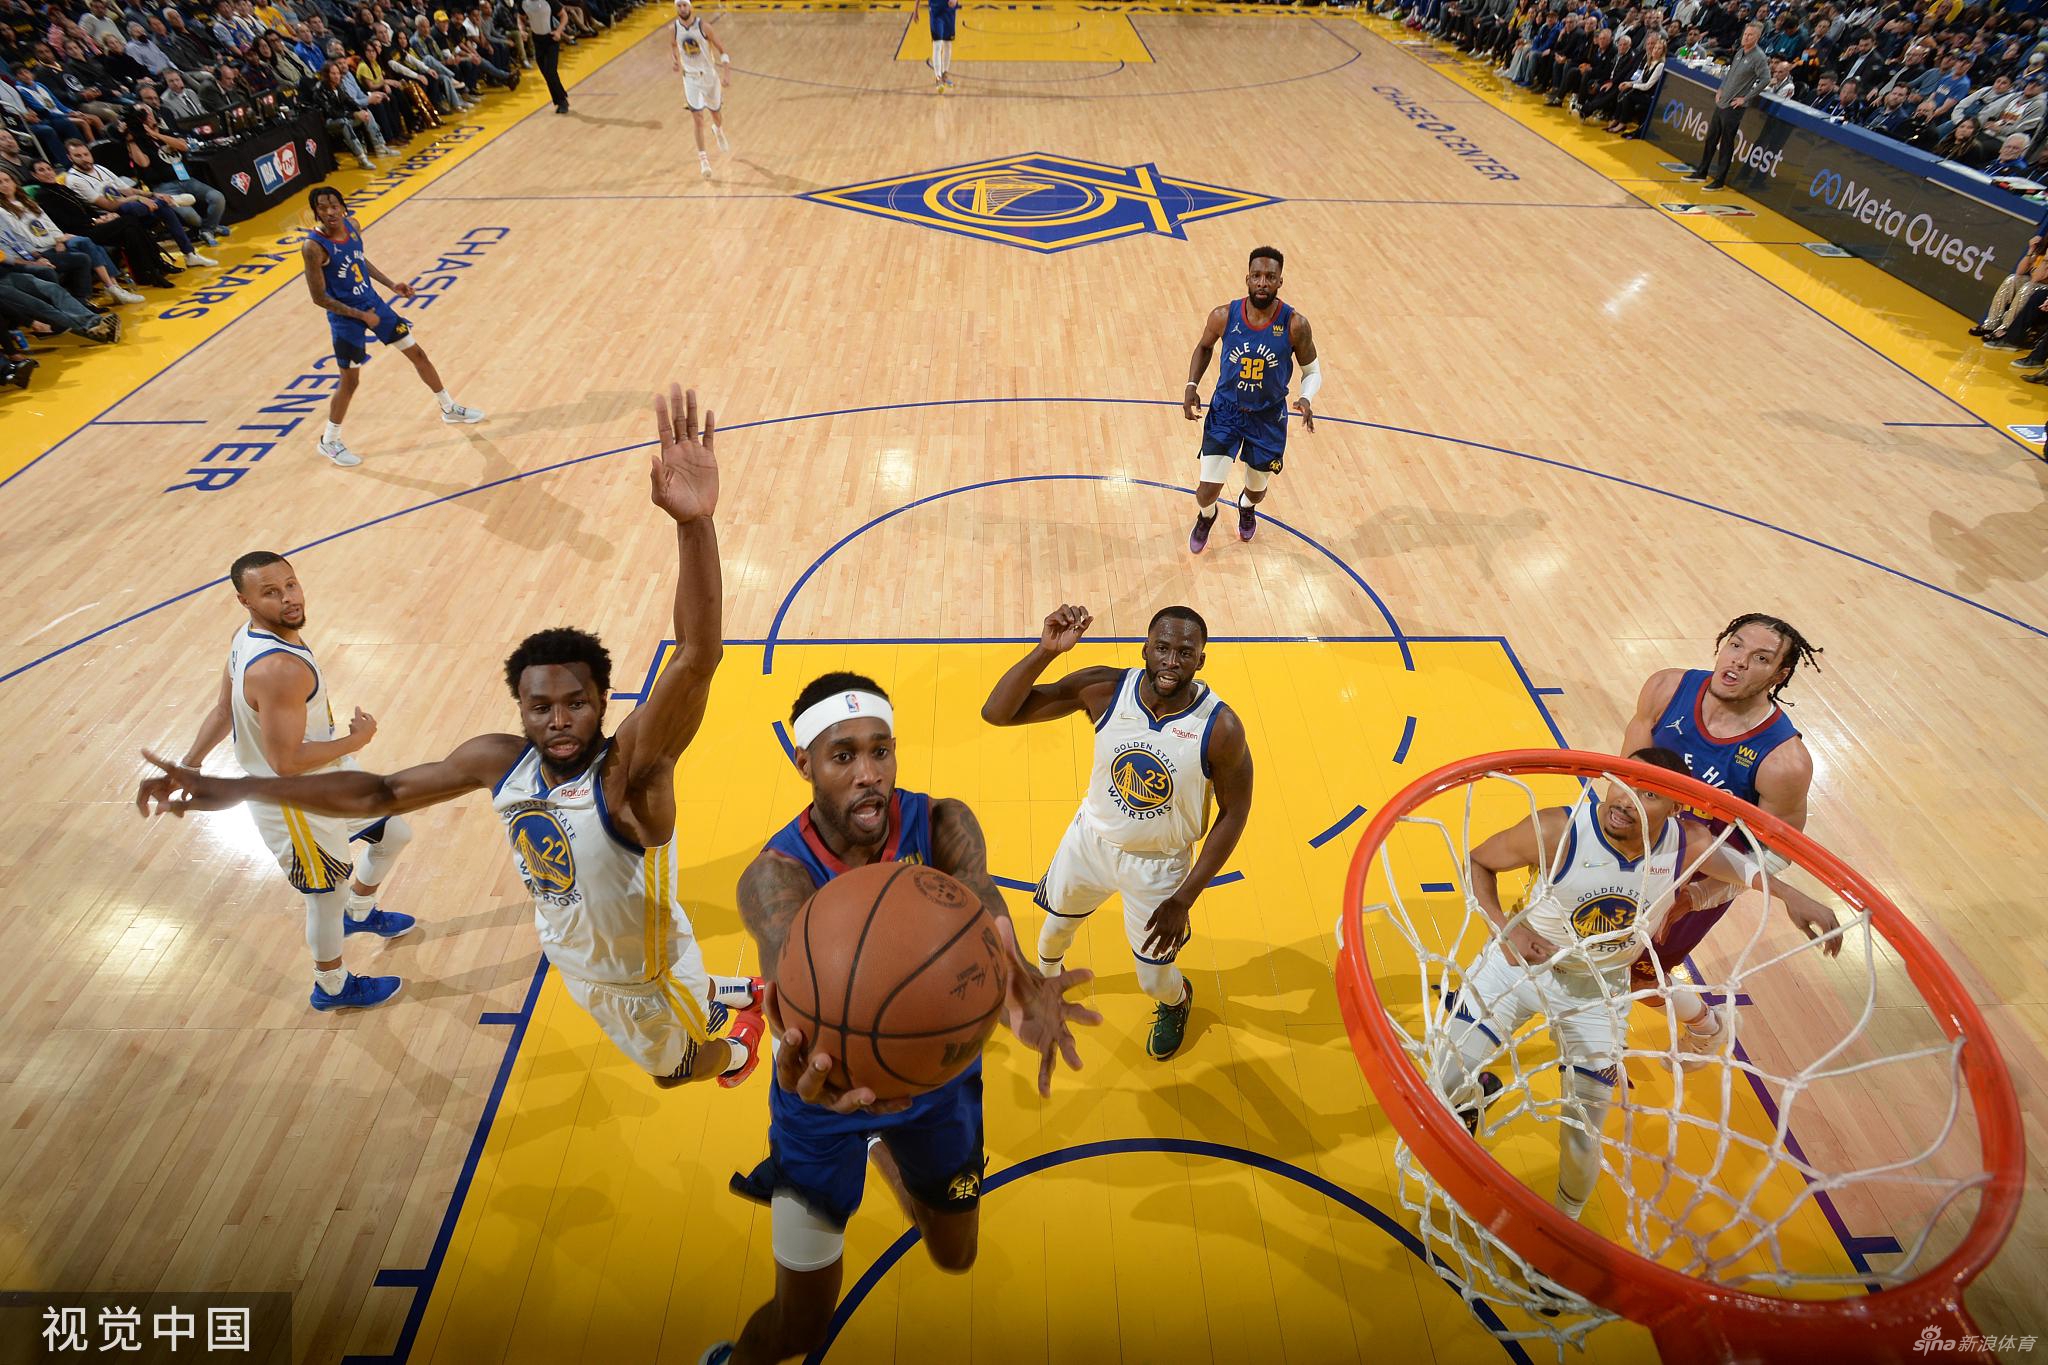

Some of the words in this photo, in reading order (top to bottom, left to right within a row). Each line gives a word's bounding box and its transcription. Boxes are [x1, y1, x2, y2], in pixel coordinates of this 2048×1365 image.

[1372, 86, 1440, 120] CHASE
[1435, 135, 1520, 180] CENTER
[345, 125, 485, 214] CELEBRATIN
[1837, 180, 1907, 238] Meta
[1905, 213, 1996, 281] Quest
[351, 263, 364, 283] 3
[386, 226, 511, 310] CHASE
[158, 249, 302, 320] YEARS
[1229, 342, 1251, 365] MILE
[1256, 343, 1279, 368] HIGH
[1239, 357, 1265, 380] 32
[1236, 379, 1264, 393] CITY
[1172, 727, 1198, 741] Rakuten
[1114, 741, 1153, 754] GOLDEN
[1155, 749, 1178, 775] STATE
[1739, 745, 1758, 761] WU
[561, 788, 590, 798] Rakute
[1144, 770, 1168, 790] 23
[1107, 785, 1172, 821] WARRIORS
[503, 800, 548, 819] GOLDEN
[553, 807, 577, 841] STATE
[541, 836, 567, 866] 22
[1577, 886, 1624, 902] GOLDEN
